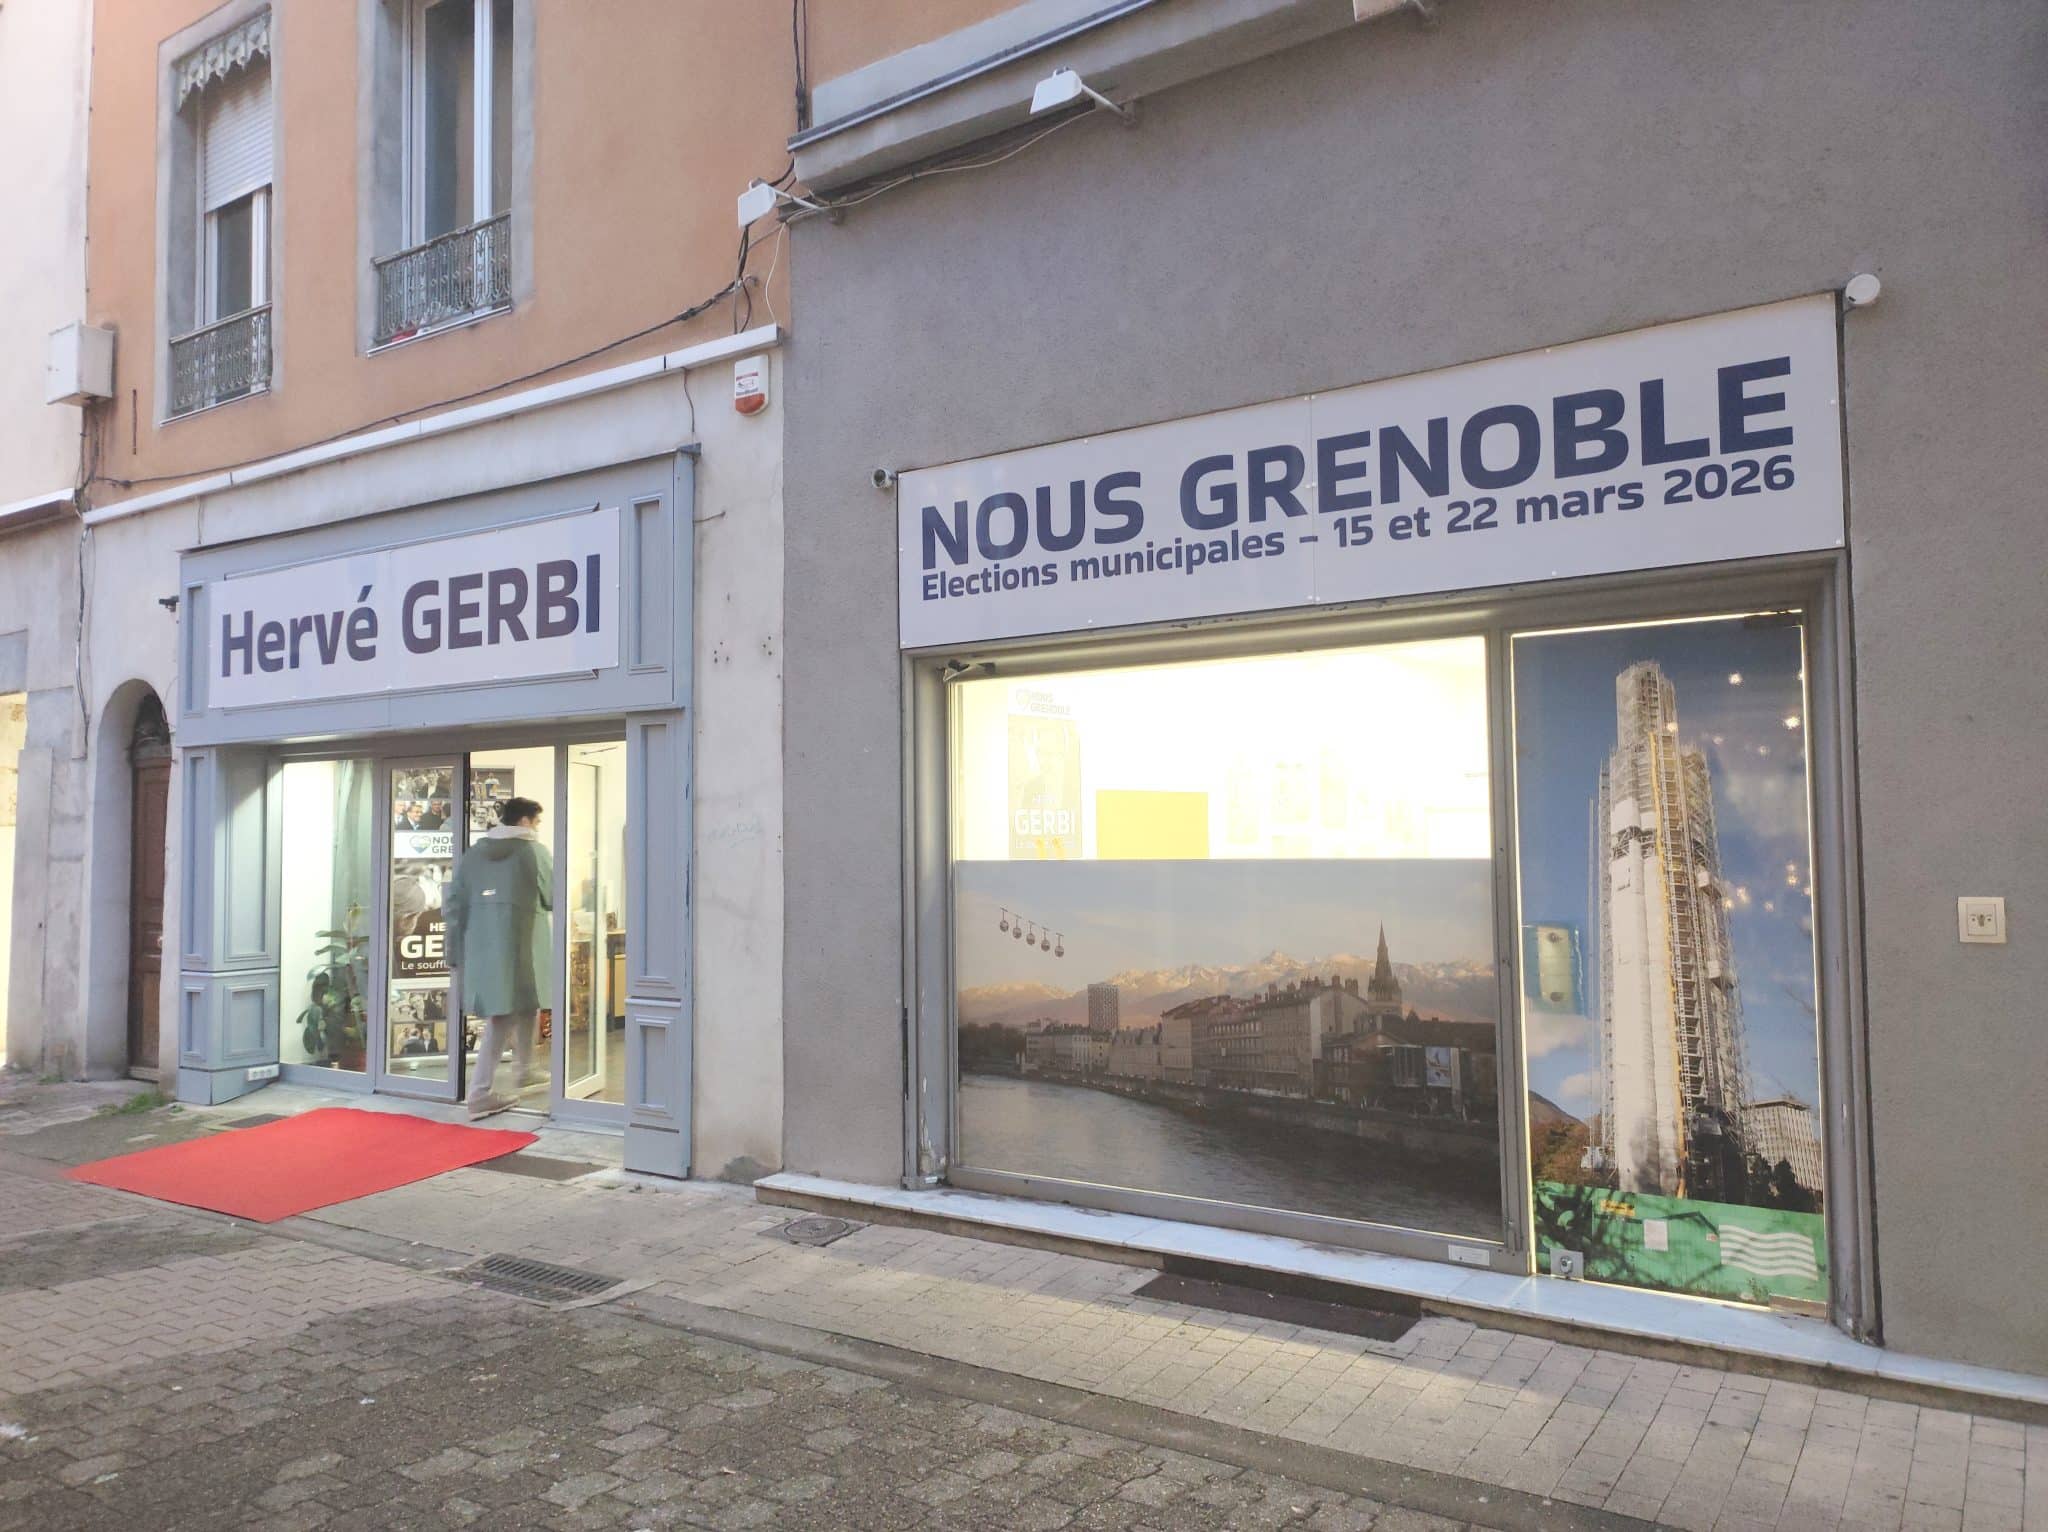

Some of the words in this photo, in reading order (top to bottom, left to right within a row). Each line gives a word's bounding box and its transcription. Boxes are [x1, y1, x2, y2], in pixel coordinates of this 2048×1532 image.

[922, 471, 1145, 570] NOUS
[1180, 356, 1794, 531] GRENOBLE
[922, 559, 1058, 600] Elections
[1070, 530, 1285, 582] municipales
[1334, 514, 1373, 548] 15
[1388, 507, 1431, 541] et
[1447, 497, 1498, 534] 22
[1517, 481, 1645, 525] mars
[1664, 454, 1795, 505] 2026
[222, 584, 378, 678] Hervé
[402, 553, 600, 654] GERBI
[1014, 807, 1075, 836] GERBI
[401, 960, 415, 970] Le
[416, 959, 449, 970] souffl
